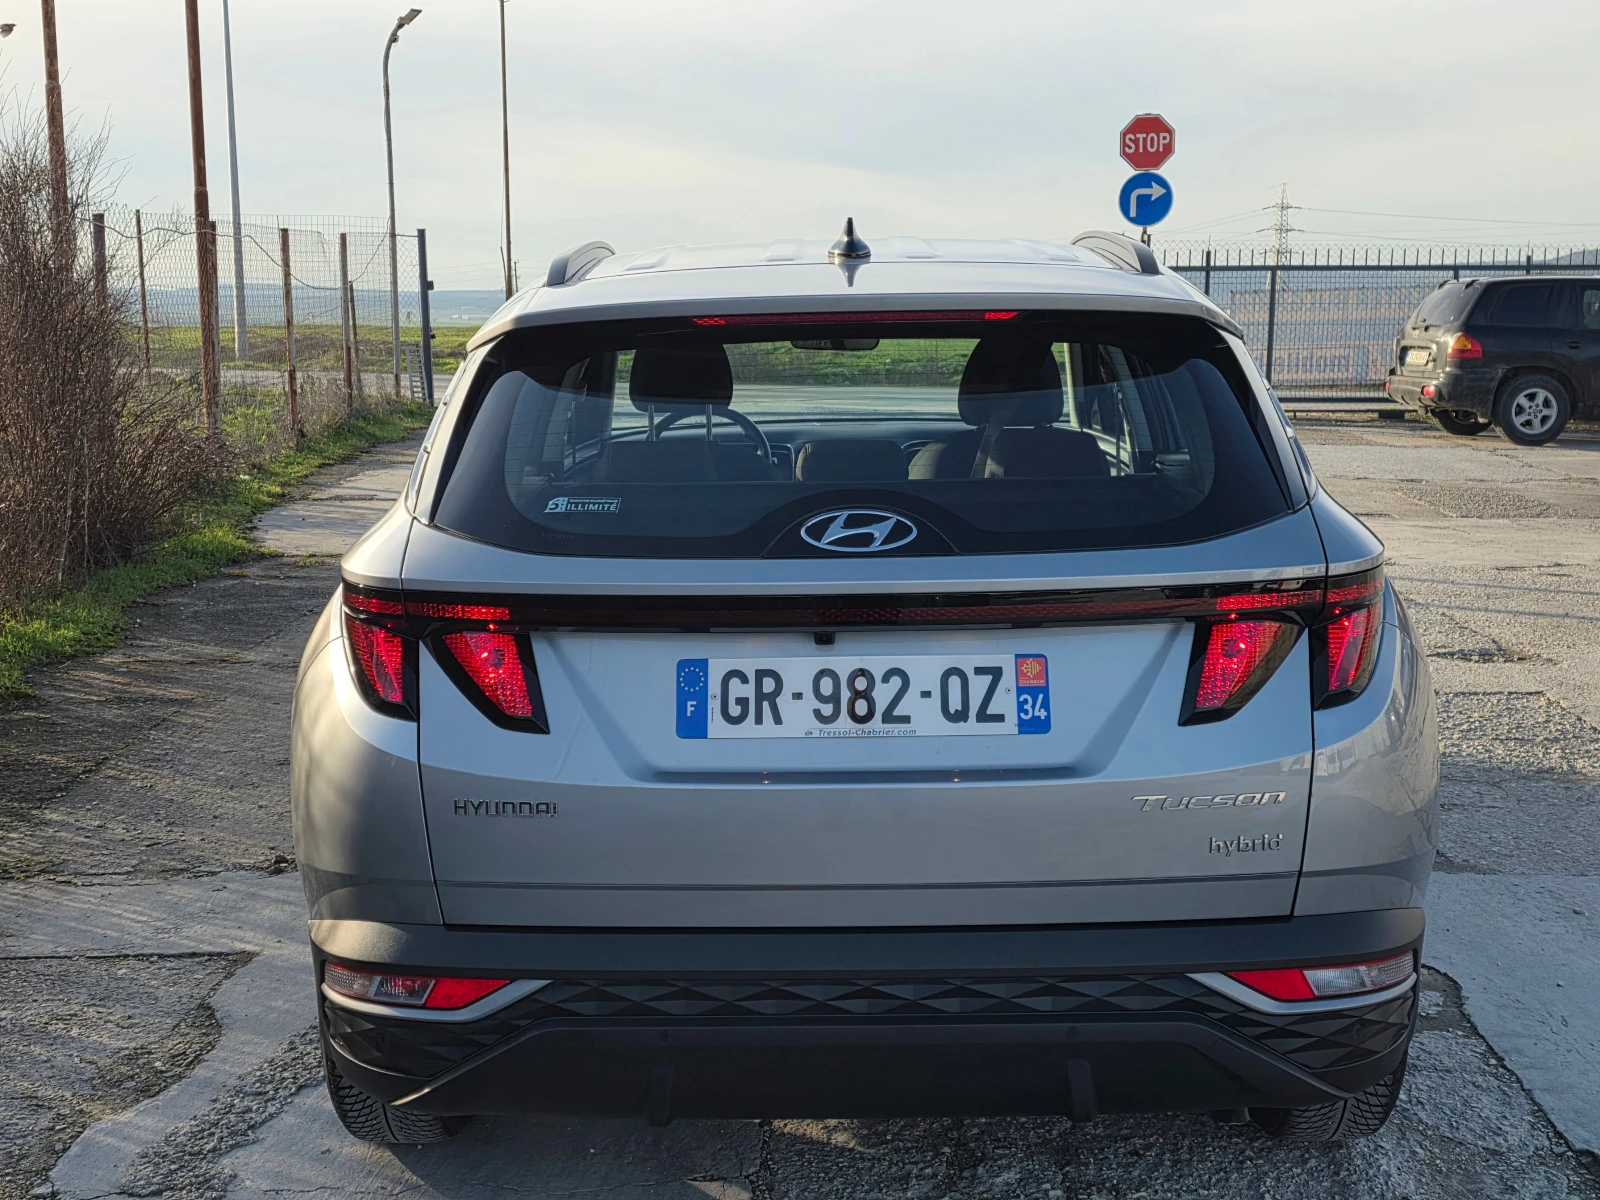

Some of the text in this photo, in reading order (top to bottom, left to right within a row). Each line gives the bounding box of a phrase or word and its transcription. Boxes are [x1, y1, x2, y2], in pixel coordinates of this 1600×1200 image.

[1125, 132, 1170, 154] STOP
[566, 502, 618, 511] ILLIMITÉ
[720, 666, 1006, 726] GR-982-QZ
[1018, 693, 1048, 720] 34
[686, 701, 697, 717] F
[818, 728, 917, 737] Tressol-Chabrier.com
[453, 798, 559, 818] HYUNDAI
[1209, 833, 1284, 857] hybrid
